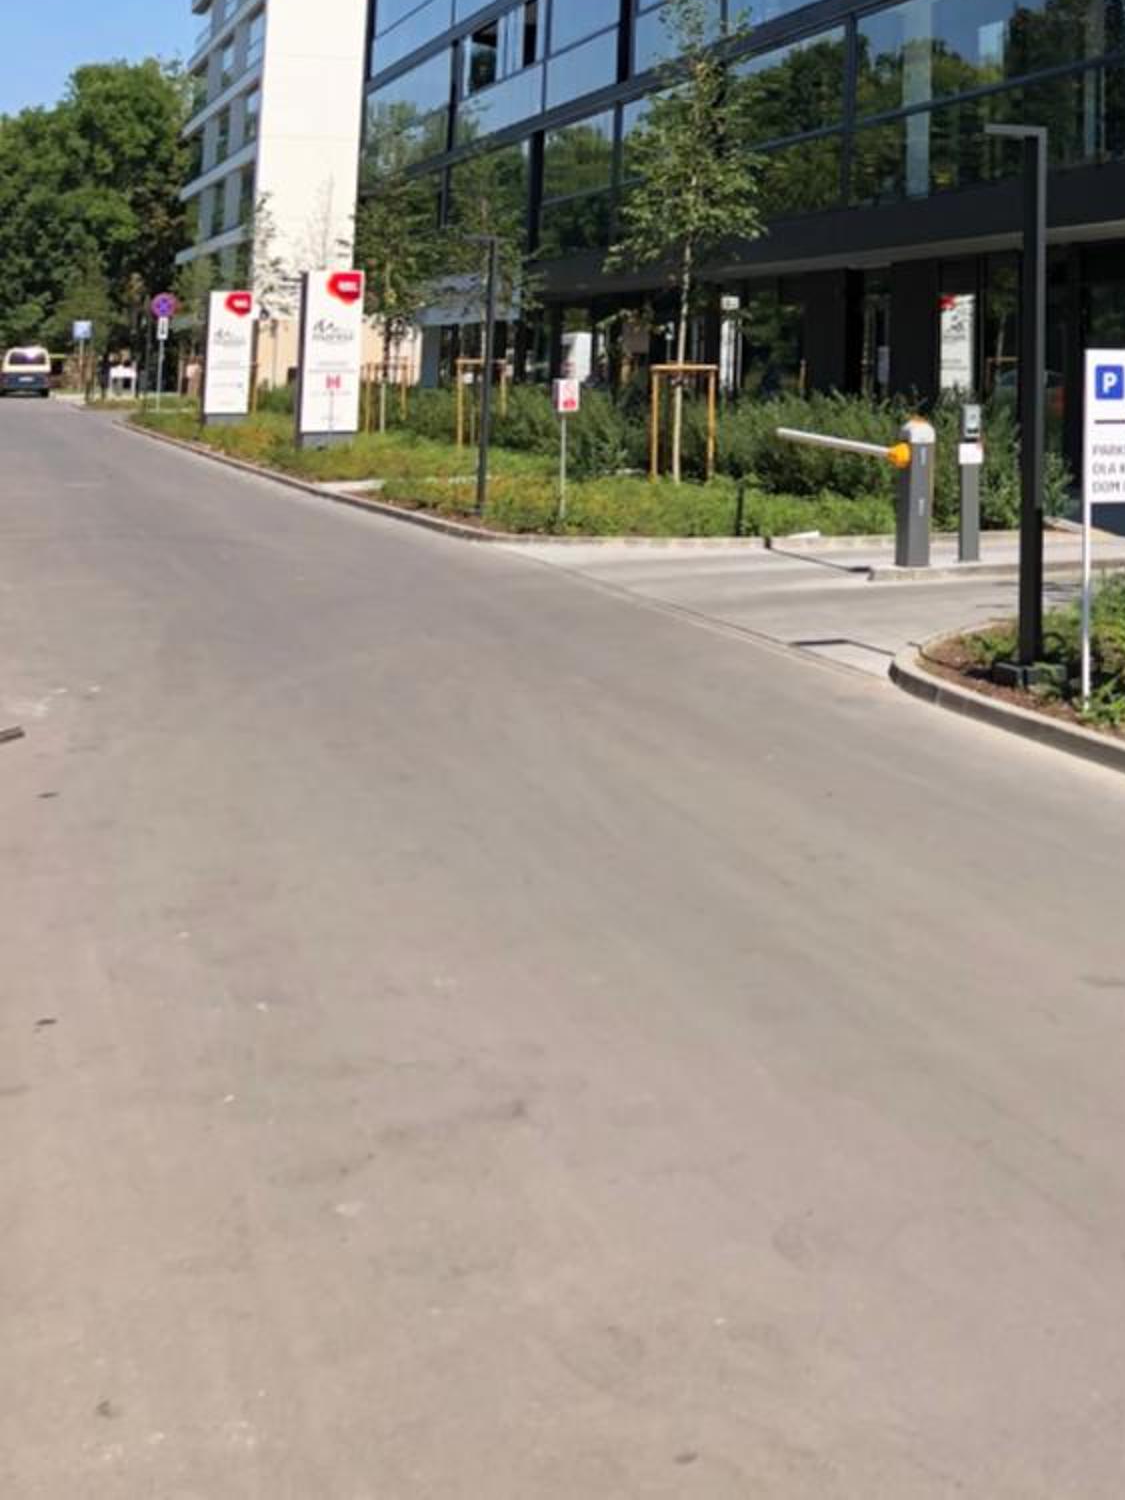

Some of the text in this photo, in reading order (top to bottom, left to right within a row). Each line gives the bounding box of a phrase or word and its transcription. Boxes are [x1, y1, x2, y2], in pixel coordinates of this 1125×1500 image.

[1102, 371, 1118, 395] P
[1092, 461, 1117, 475] DLA
[1092, 480, 1120, 494] DOM
